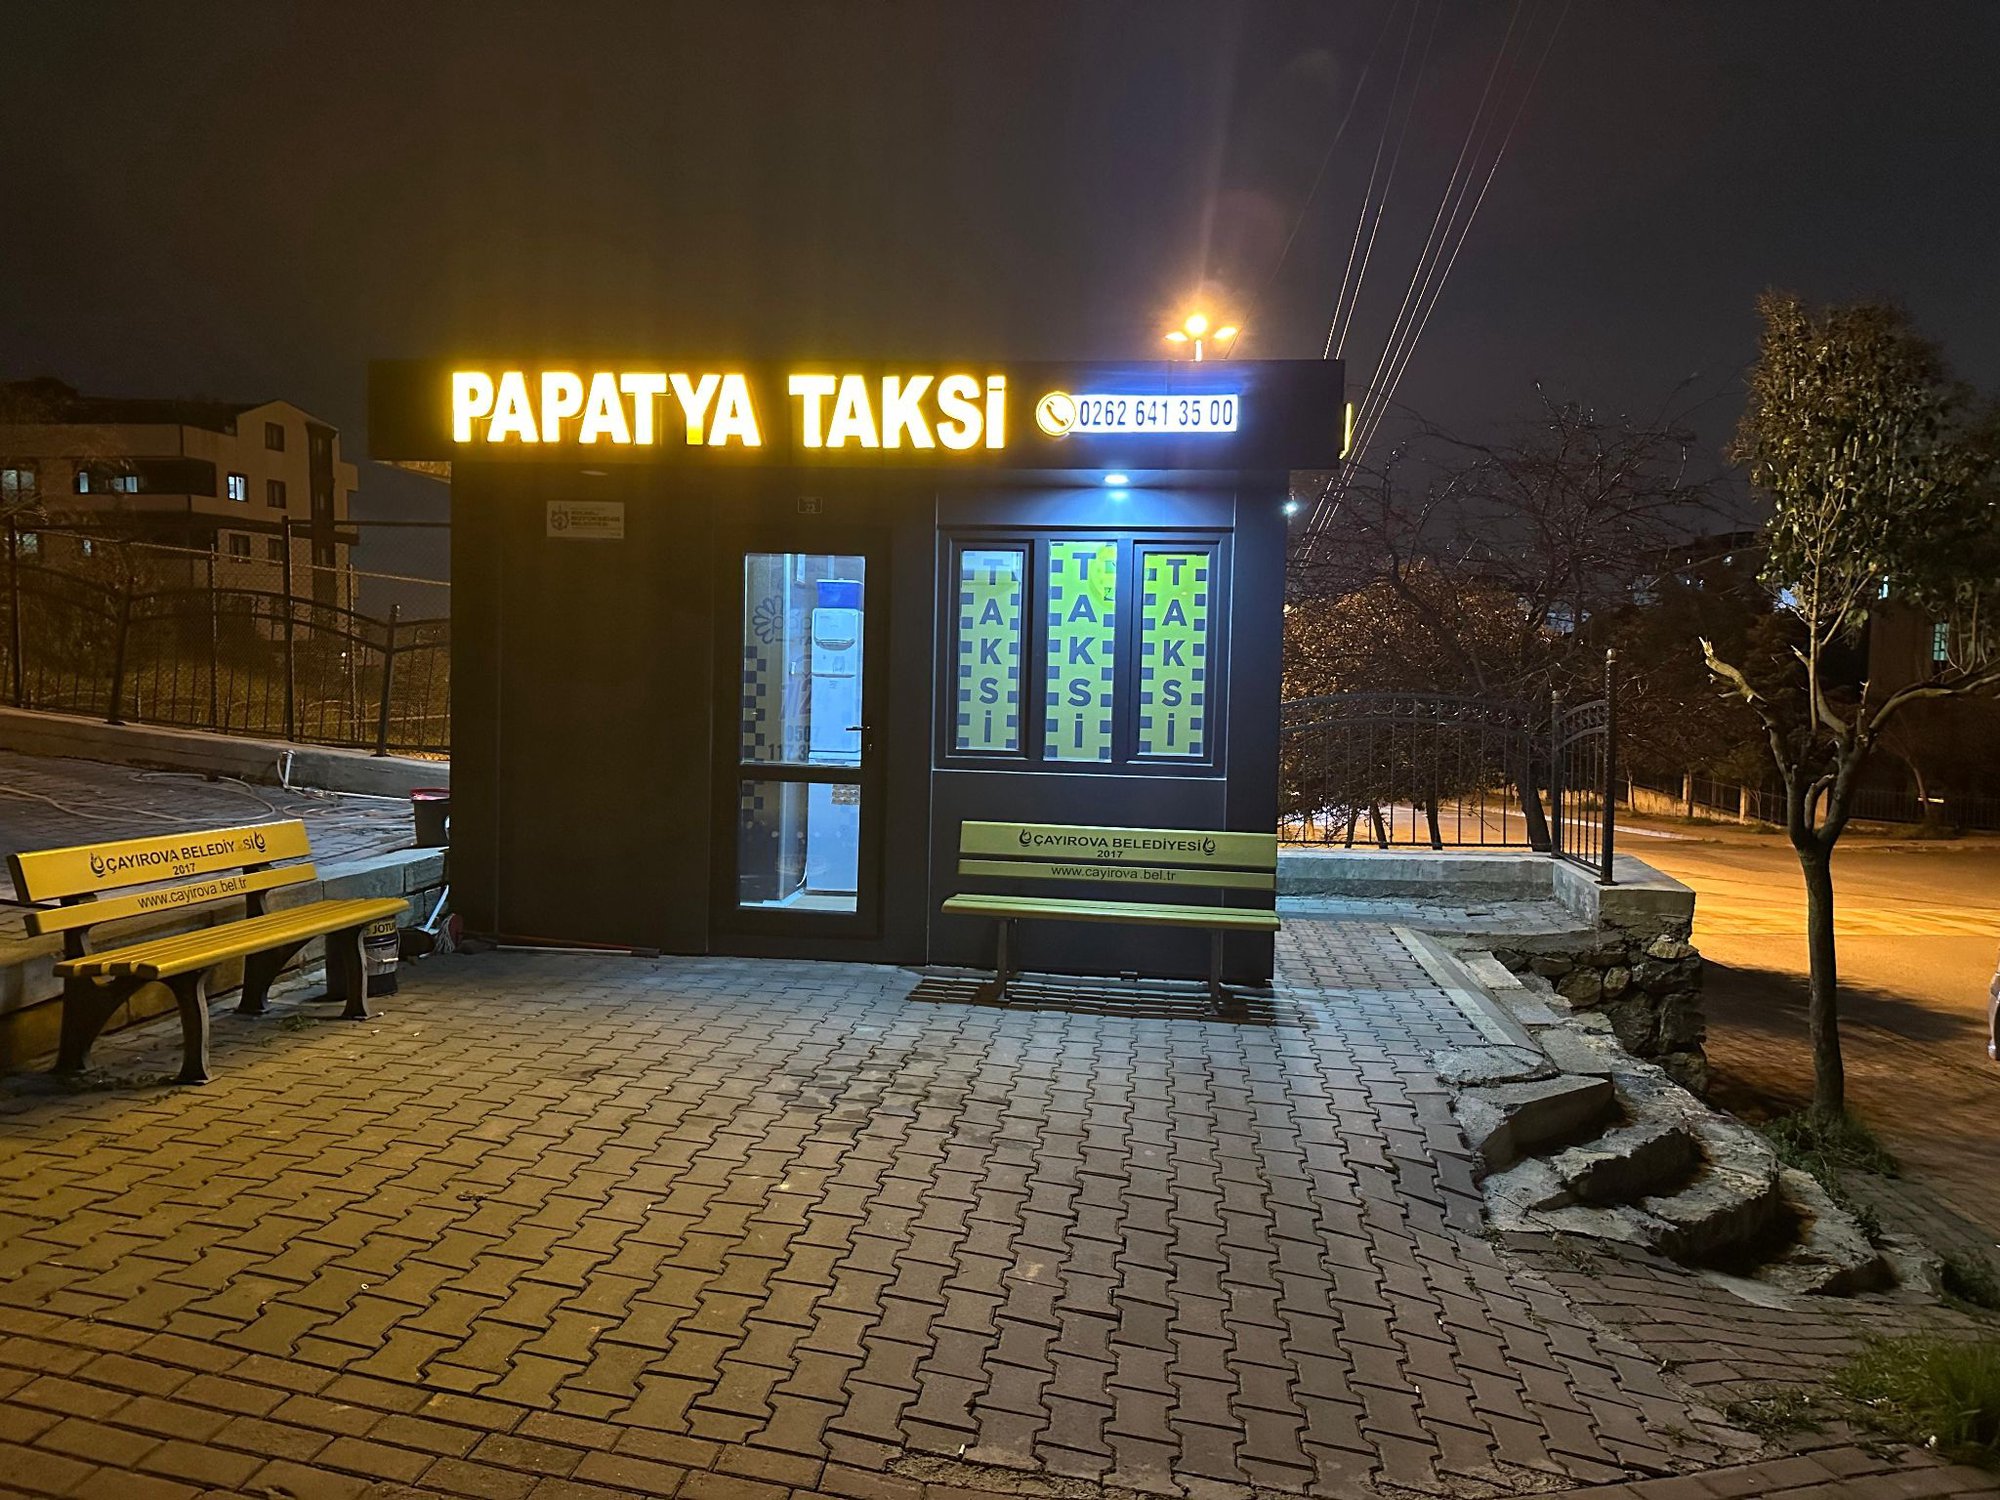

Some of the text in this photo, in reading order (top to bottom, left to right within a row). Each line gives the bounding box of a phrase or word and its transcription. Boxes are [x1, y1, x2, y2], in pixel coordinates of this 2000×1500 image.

[453, 372, 761, 445] PAPATYA
[1079, 400, 1233, 426] 0262 641 35 00
[1033, 834, 1201, 851] ÇAYIROVA BELEDİYESİ
[106, 836, 255, 873] ÇAYIROVA BELEDİYSİ
[1097, 850, 1123, 858] 2017
[172, 862, 196, 876] 2017
